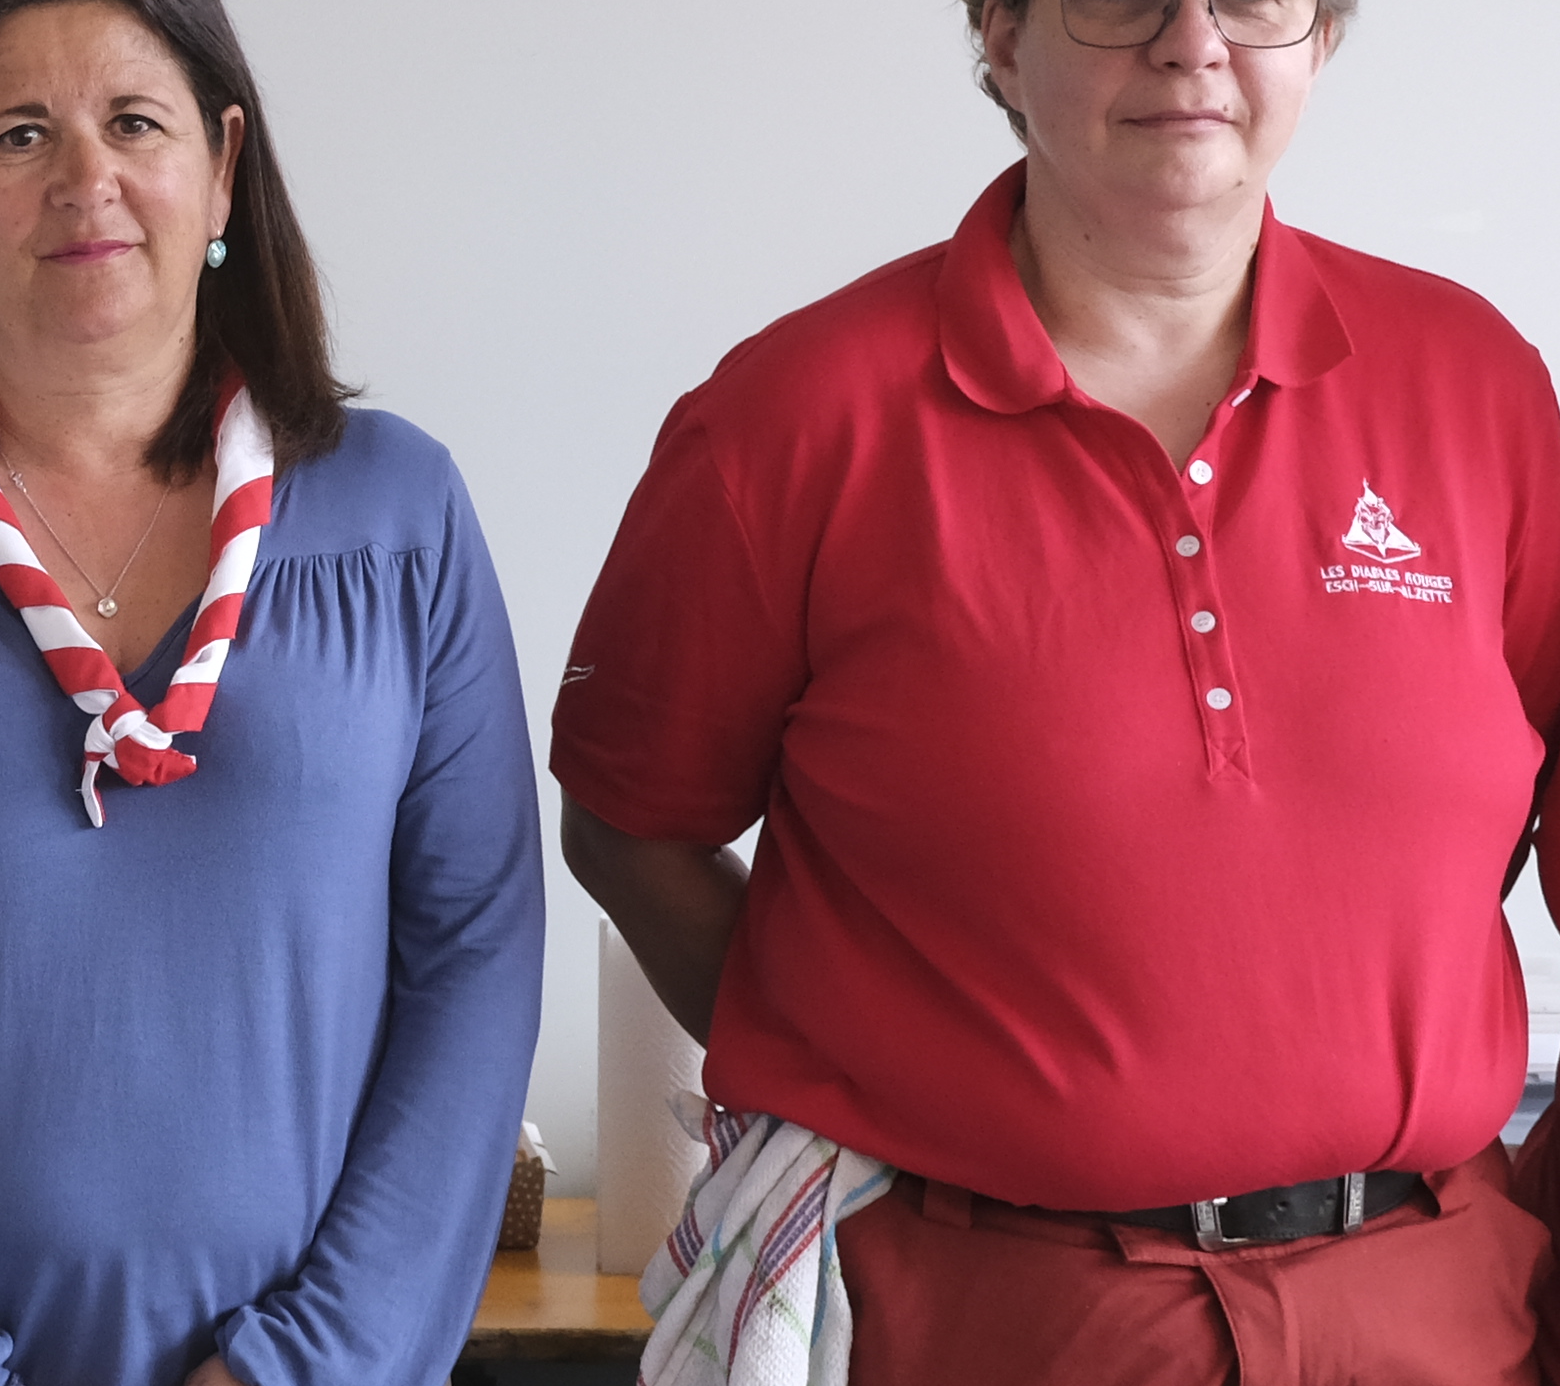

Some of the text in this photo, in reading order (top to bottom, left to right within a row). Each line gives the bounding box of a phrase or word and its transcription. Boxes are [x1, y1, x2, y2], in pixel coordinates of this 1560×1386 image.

[1320, 565, 1453, 589] LES DIABLES ROUGES
